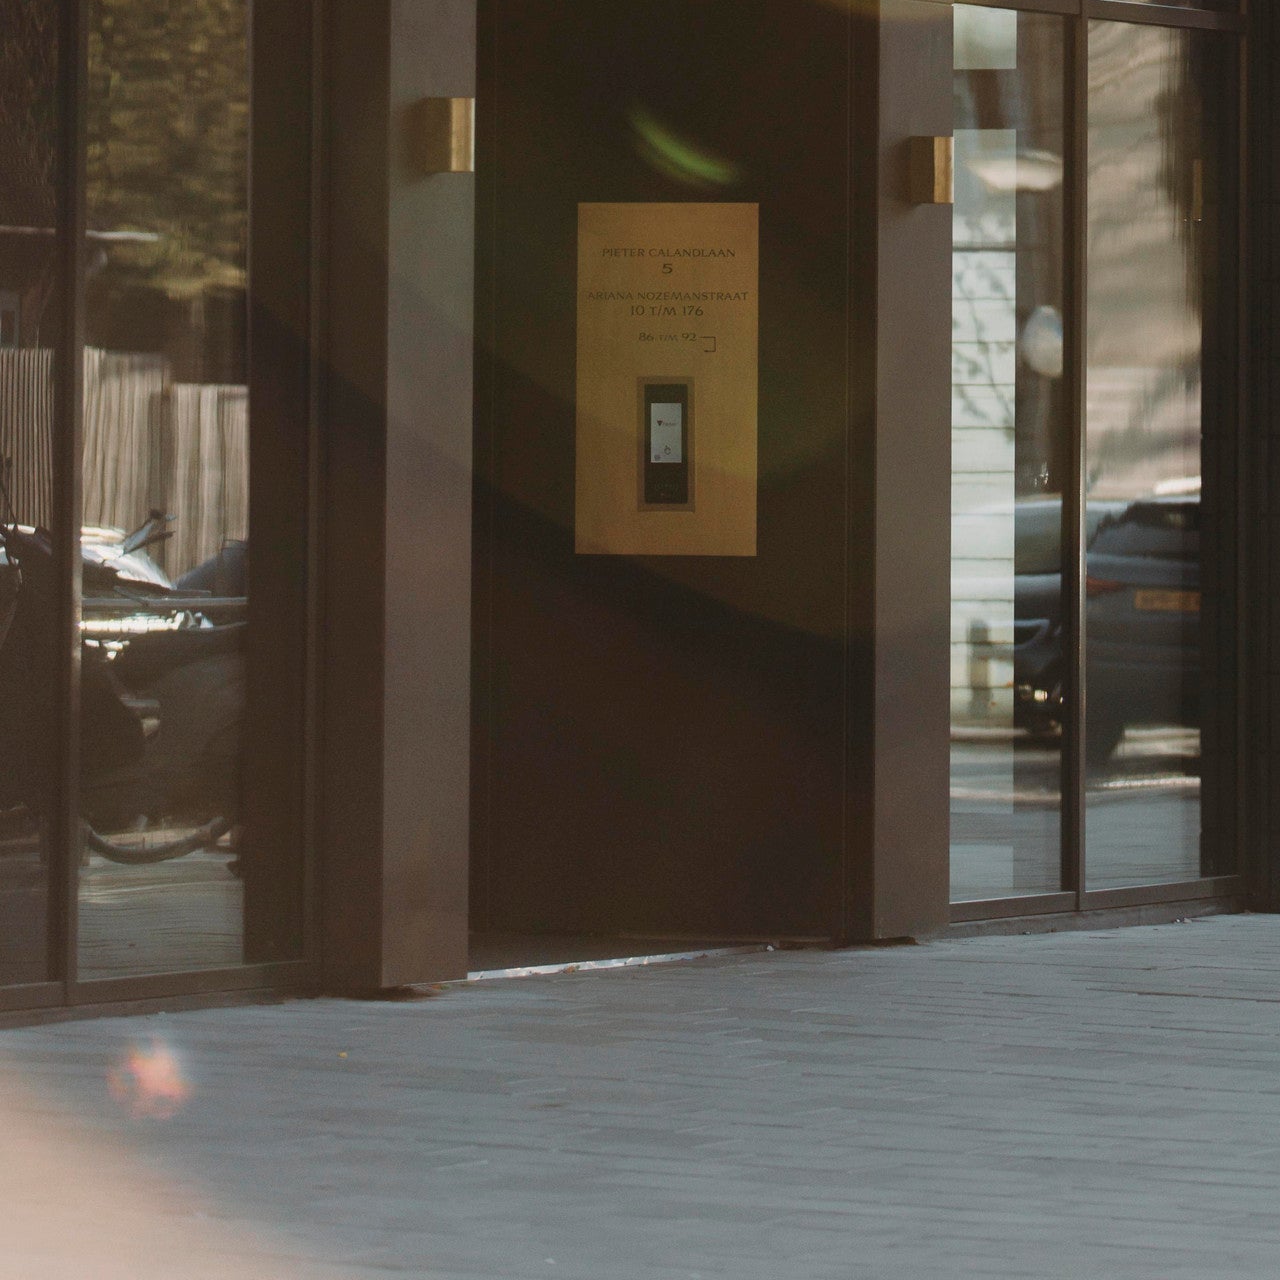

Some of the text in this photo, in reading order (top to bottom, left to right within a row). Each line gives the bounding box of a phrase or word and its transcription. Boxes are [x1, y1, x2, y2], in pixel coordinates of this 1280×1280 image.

[602, 248, 736, 258] PIETER CALANDLAAN
[661, 263, 674, 275] 5
[588, 291, 749, 301] ARIANA NOZEMANSTRAAT
[631, 305, 704, 317] 10 T/M 176
[638, 332, 654, 342] 86
[681, 332, 697, 342] 92
